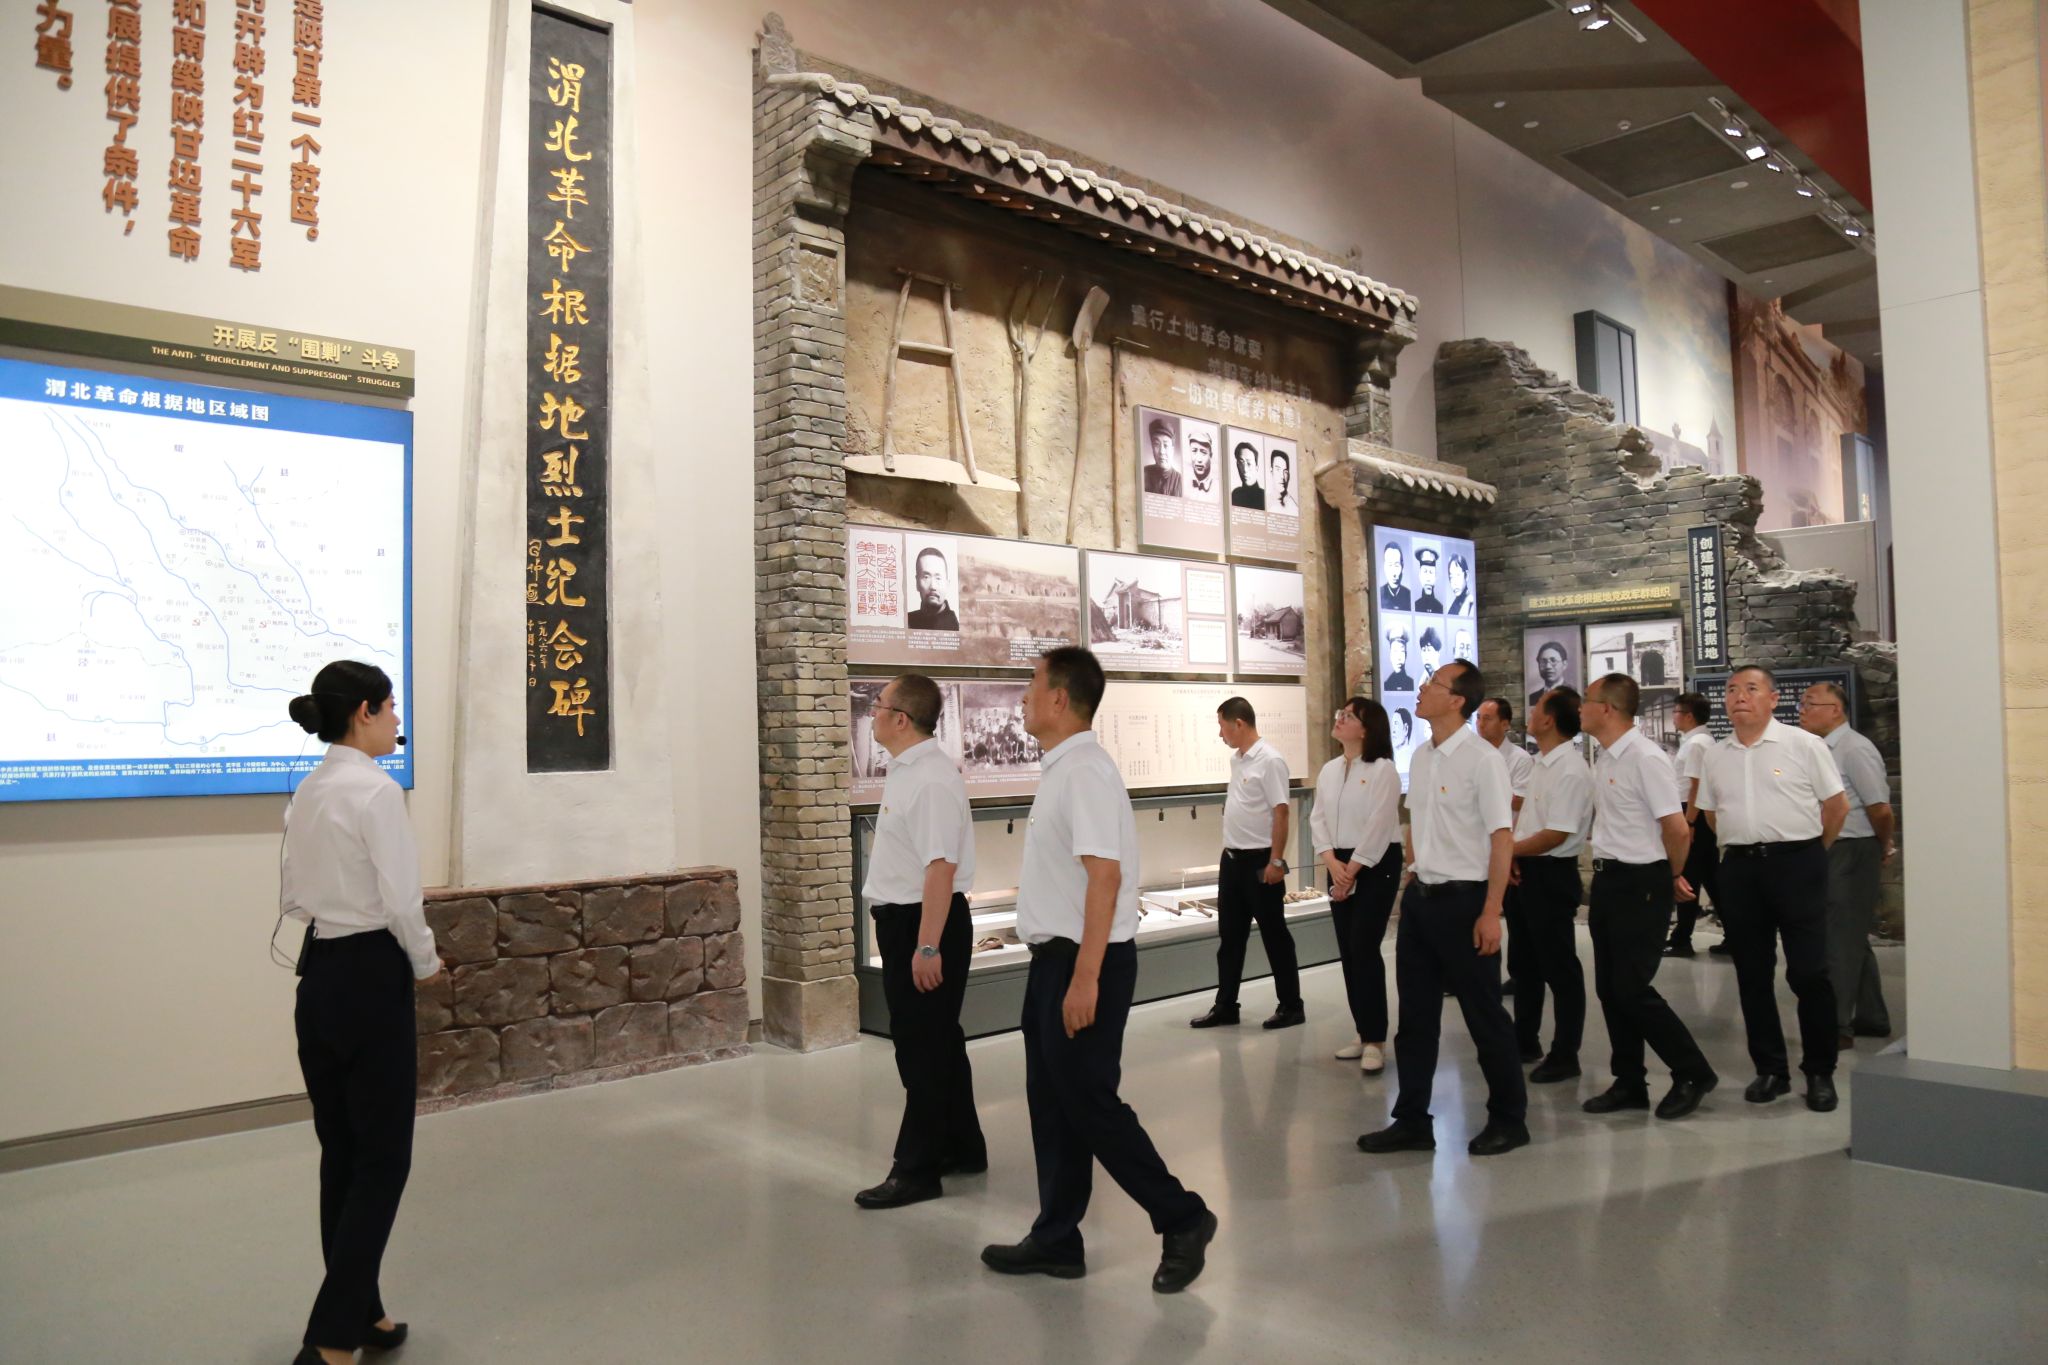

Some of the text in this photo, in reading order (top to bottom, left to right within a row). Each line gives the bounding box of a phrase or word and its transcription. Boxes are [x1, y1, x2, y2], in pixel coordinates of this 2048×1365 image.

[151, 346, 169, 357] THE
[271, 365, 291, 374] AND
[356, 376, 401, 389] STRUGGLES
[45, 378, 270, 422] 渭北革命根据地区域图
[1700, 536, 1719, 660] 创建渭北革命根据地
